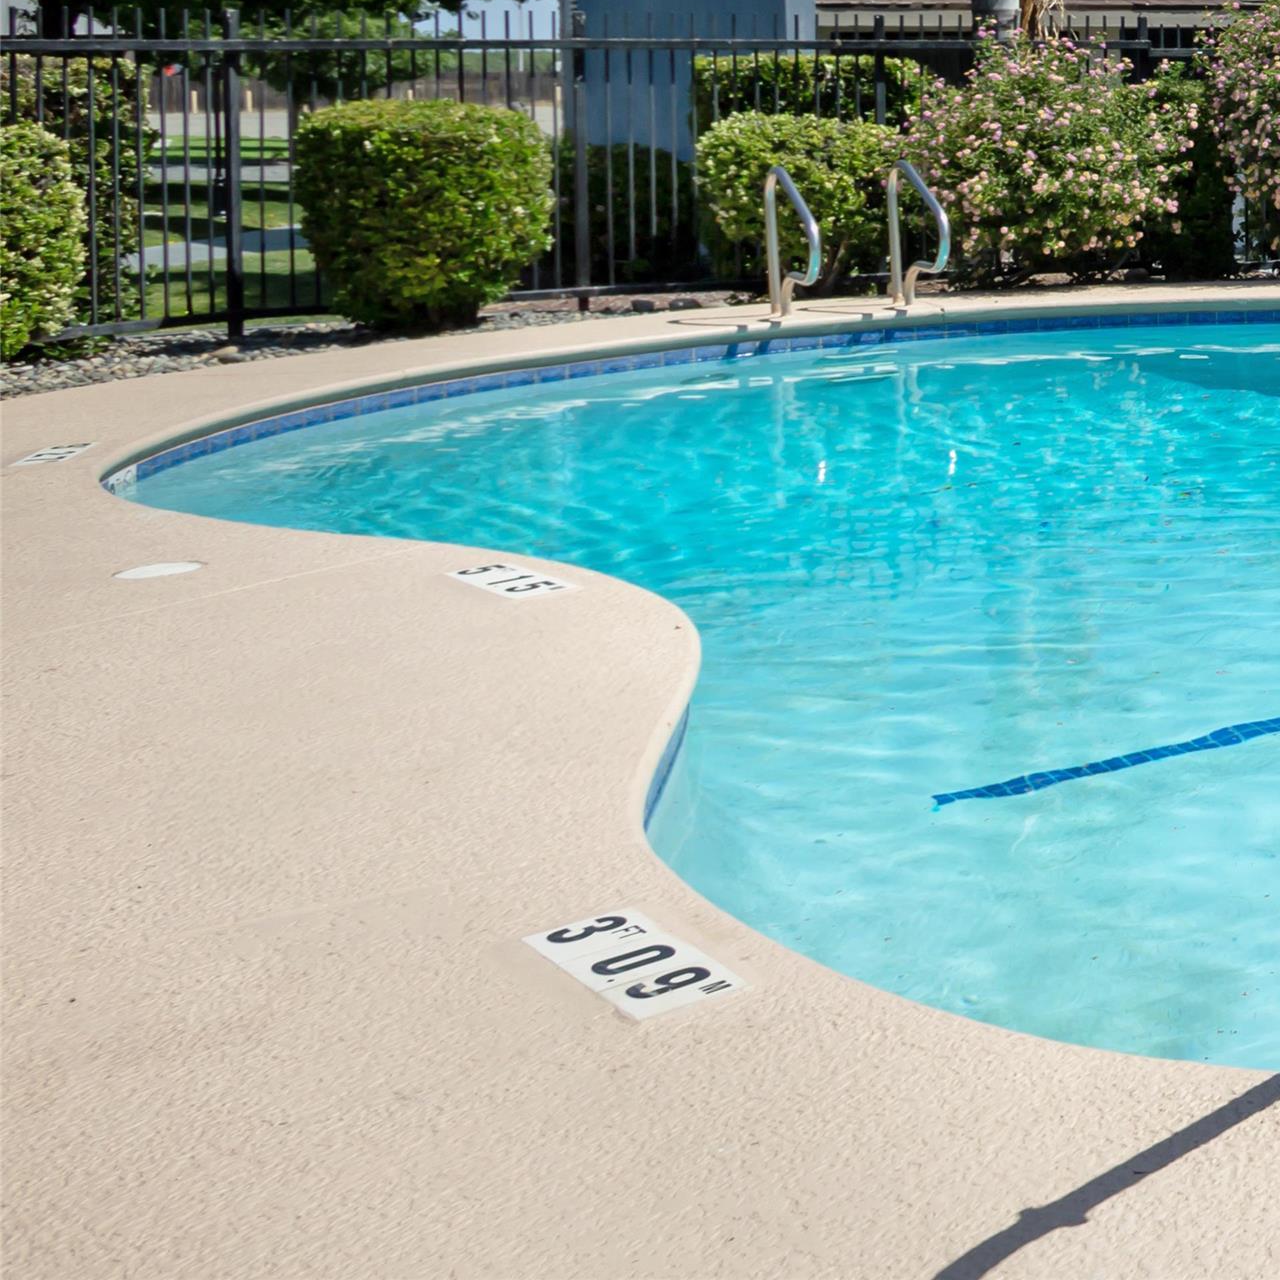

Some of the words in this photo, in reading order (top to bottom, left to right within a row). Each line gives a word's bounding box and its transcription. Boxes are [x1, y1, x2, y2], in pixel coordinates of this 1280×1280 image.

[457, 564, 506, 575] 5
[546, 916, 627, 944] 3
[611, 925, 647, 939] FT
